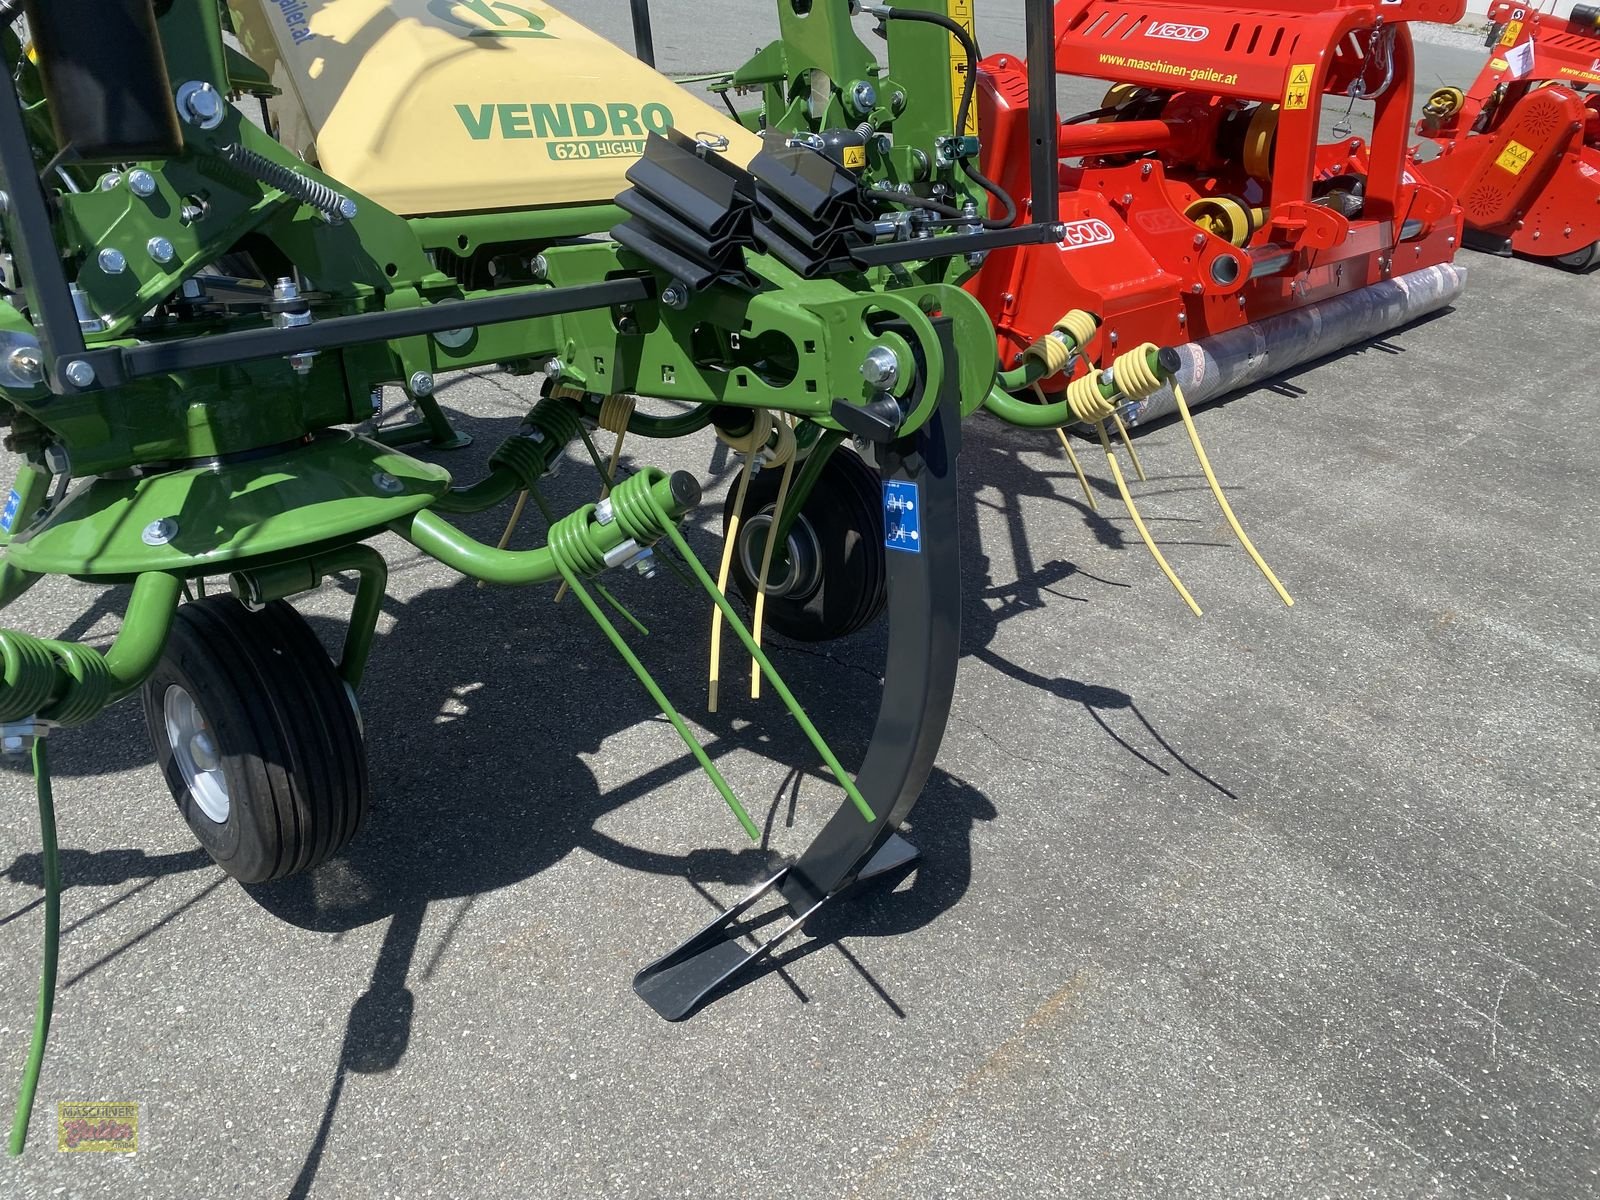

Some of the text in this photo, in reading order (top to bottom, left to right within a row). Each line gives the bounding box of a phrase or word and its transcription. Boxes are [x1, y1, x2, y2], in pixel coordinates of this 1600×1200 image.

[1099, 53, 1238, 85] www.maschinen-gailer.at
[453, 102, 675, 140] VENDRO
[555, 143, 591, 159] 620
